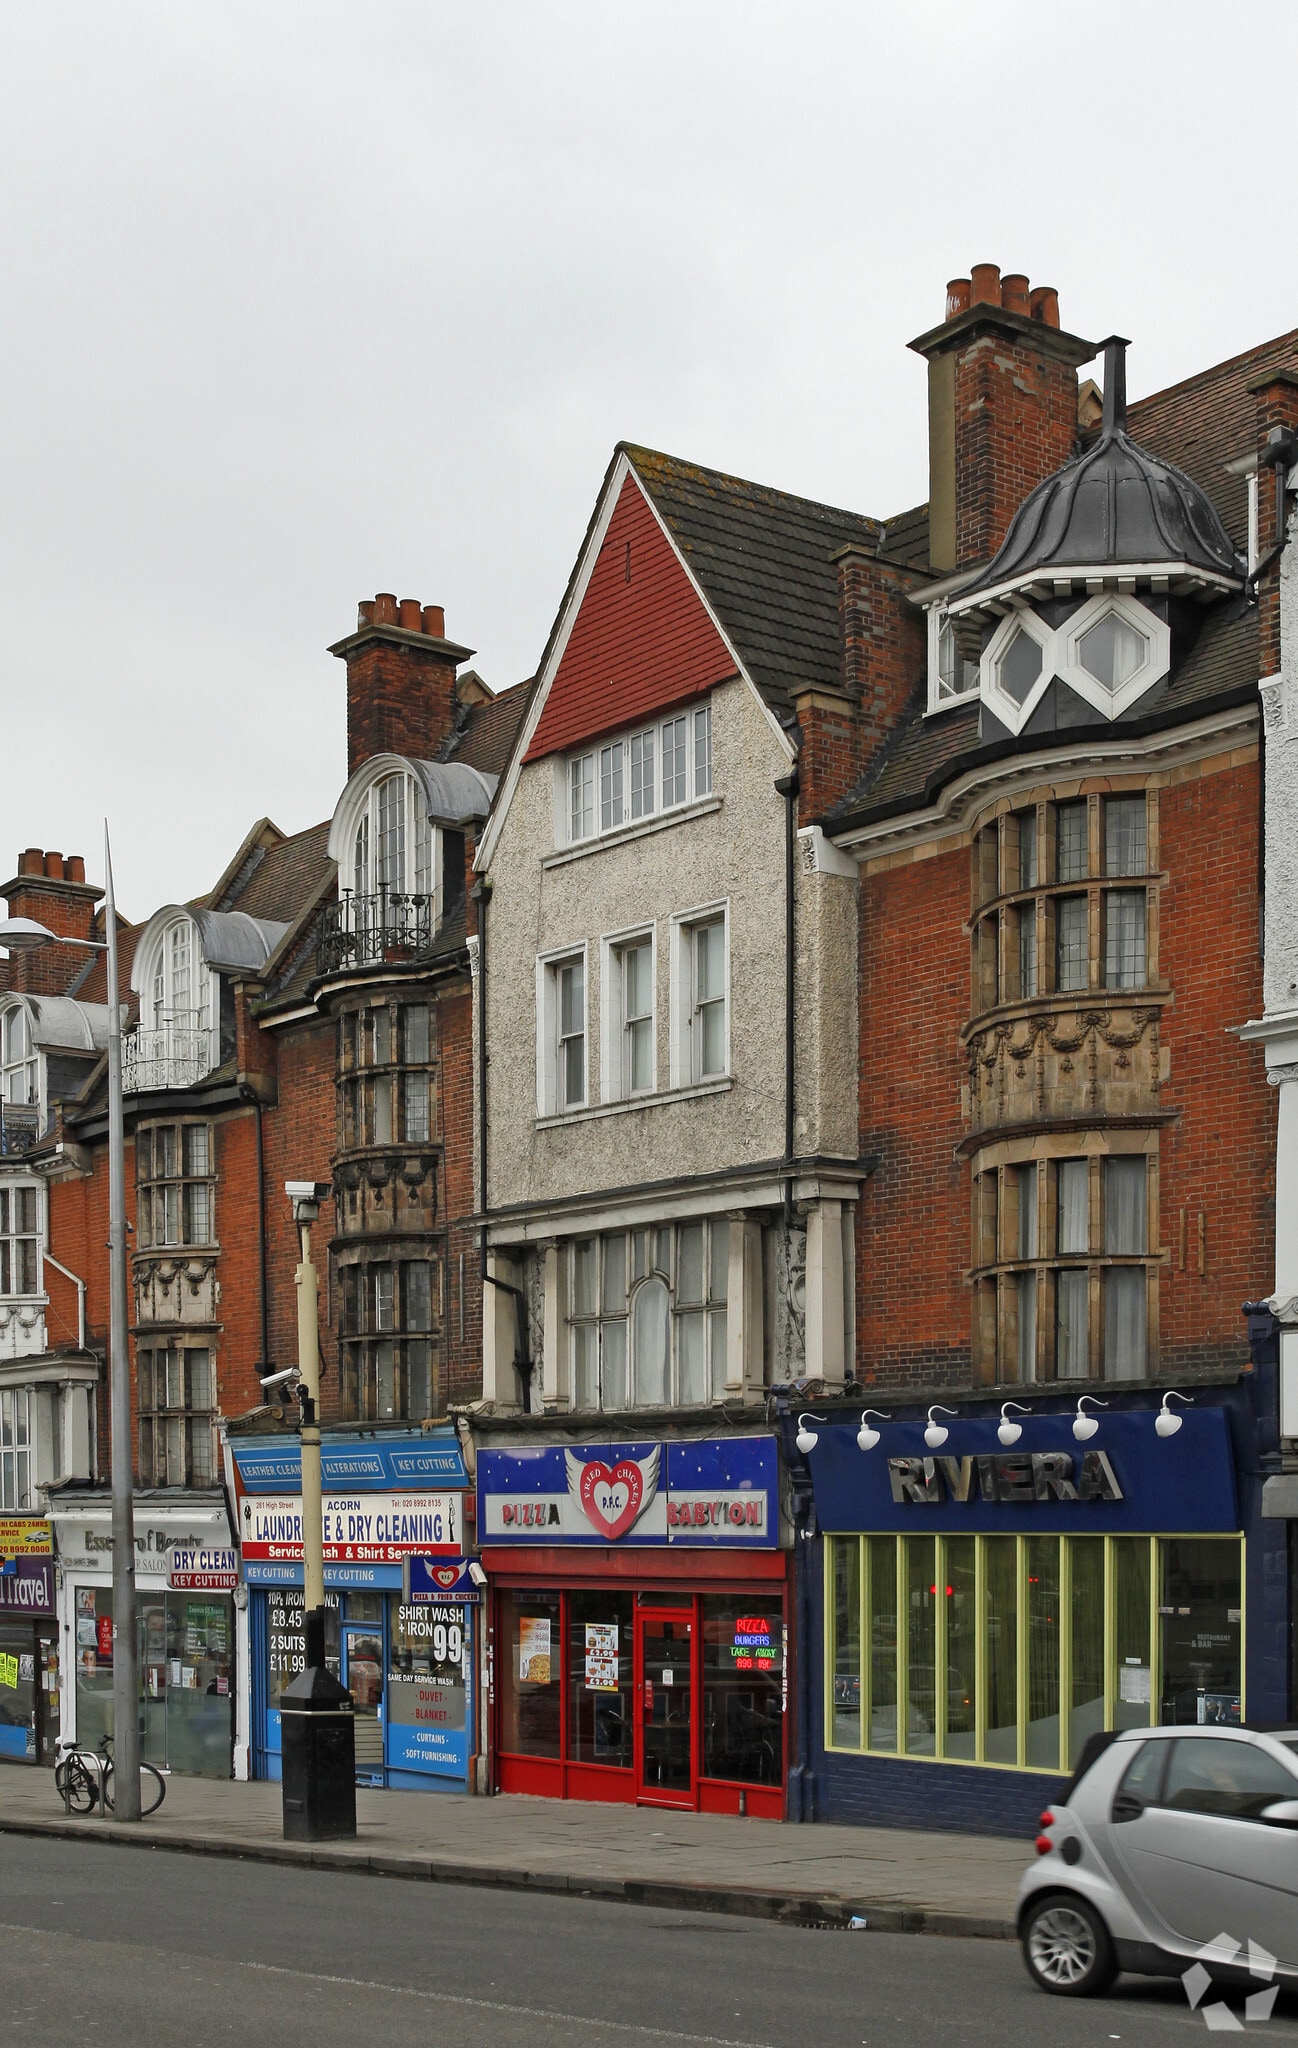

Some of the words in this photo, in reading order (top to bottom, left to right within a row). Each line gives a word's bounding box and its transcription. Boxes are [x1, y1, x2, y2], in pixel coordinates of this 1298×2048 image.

[242, 1465, 276, 1476] LEATHER
[276, 1464, 302, 1475] CLEAN
[325, 1461, 379, 1474] ALTERATIONS
[398, 1459, 415, 1471] KEY
[417, 1458, 456, 1470] CUTTING
[887, 1450, 1124, 1503] RIVIERA
[584, 1468, 601, 1499] FRIED
[617, 1468, 639, 1508] CHICKEN
[265, 1502, 278, 1510] High
[327, 1501, 361, 1511] ACORN
[413, 1499, 427, 1507] 8992
[427, 1499, 442, 1507] 8135
[502, 1503, 561, 1526] PIZZA
[9, 1520, 26, 1528] CABS
[27, 1520, 49, 1528] 24HRS
[256, 1515, 331, 1541] LAUNDRE
[335, 1515, 344, 1542] &
[348, 1515, 372, 1542] DRY
[376, 1514, 443, 1542] CLEANING
[10, 1545, 30, 1553] 8992
[30, 1545, 50, 1553] 0000
[345, 1546, 354, 1559] &
[357, 1546, 385, 1559] Shirt
[174, 1551, 196, 1570] DRY
[200, 1551, 235, 1570] CLEAN
[247, 1567, 262, 1577] KEY
[262, 1567, 295, 1578] CUTTING
[323, 1569, 337, 1579] KEY
[338, 1569, 374, 1580] CUTTING
[173, 1575, 191, 1587] KEY
[194, 1575, 236, 1587] CUTTING
[324, 1593, 340, 1608] NLY
[414, 1593, 429, 1601] PIZZA
[437, 1593, 453, 1601] FRIED
[272, 1609, 302, 1628] £8.45
[398, 1605, 430, 1621] SHIRT
[431, 1607, 464, 1623] WASH
[407, 1621, 433, 1637] IRON
[736, 1618, 769, 1633] PIZZA
[270, 1635, 277, 1650] 2
[277, 1635, 306, 1651] SUITS
[433, 1624, 462, 1663] 99
[734, 1635, 770, 1646] BURGERS
[1197, 1633, 1231, 1641] RESTAURANT
[1197, 1640, 1212, 1648] BAR
[730, 1646, 751, 1657] TAKE
[754, 1647, 777, 1658] AWAY
[269, 1653, 306, 1673] £11.99
[387, 1673, 402, 1682] SAME
[402, 1674, 414, 1682] DAY
[414, 1674, 437, 1685] SERVICE
[437, 1677, 454, 1686] WASH
[419, 1690, 443, 1702] DUVET
[415, 1708, 448, 1722] BLANKET
[416, 1732, 446, 1744] CURTAINS
[405, 1749, 420, 1759] SOFT
[421, 1750, 457, 1763] FURNISHING
